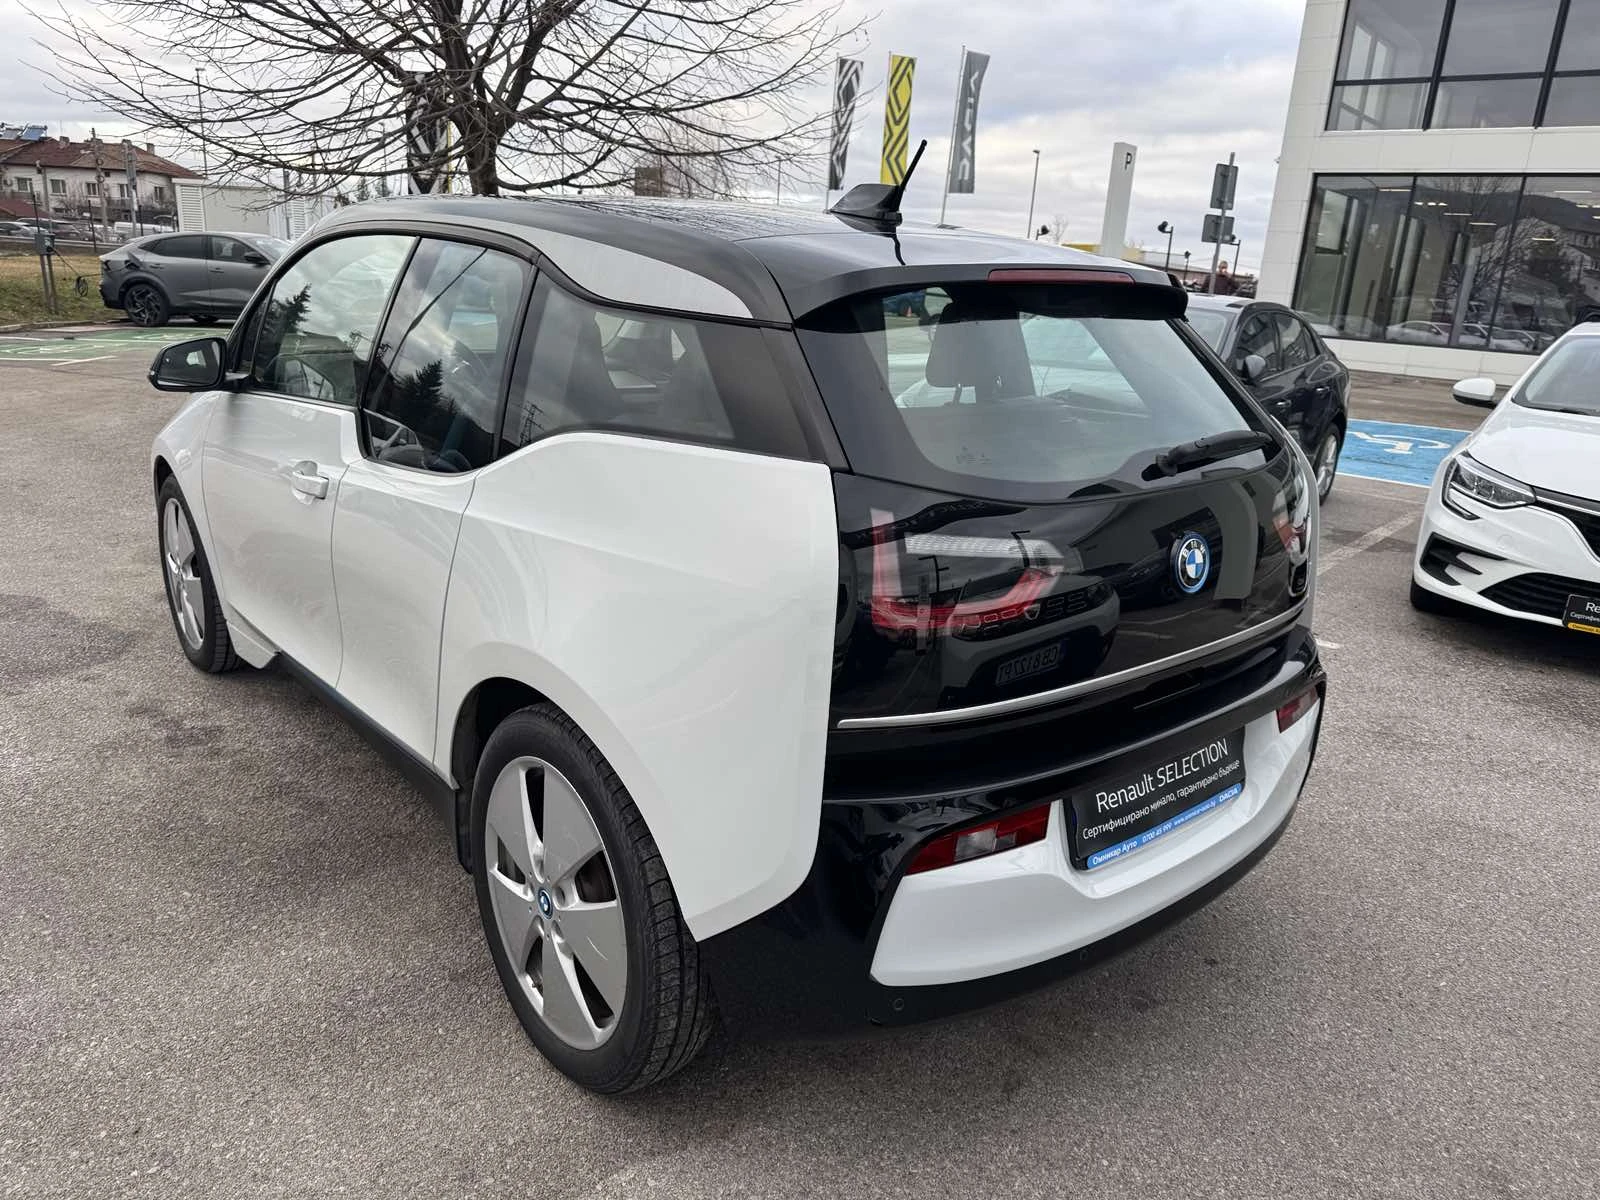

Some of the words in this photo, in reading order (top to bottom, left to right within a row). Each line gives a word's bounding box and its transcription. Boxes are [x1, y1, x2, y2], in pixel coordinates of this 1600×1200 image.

[1124, 151, 1133, 171] P
[1182, 540, 1206, 558] BMW
[1096, 773, 1155, 813] Renault
[1157, 738, 1229, 788] SELECTION
[1082, 806, 1150, 840] Сертифицирано
[1151, 792, 1177, 812] минало,
[1177, 772, 1219, 798] гарантирано
[1219, 760, 1240, 778] бъдеще
[1092, 848, 1121, 865] Омникар
[1122, 841, 1137, 853] Ауто
[1142, 832, 1155, 843] 0700
